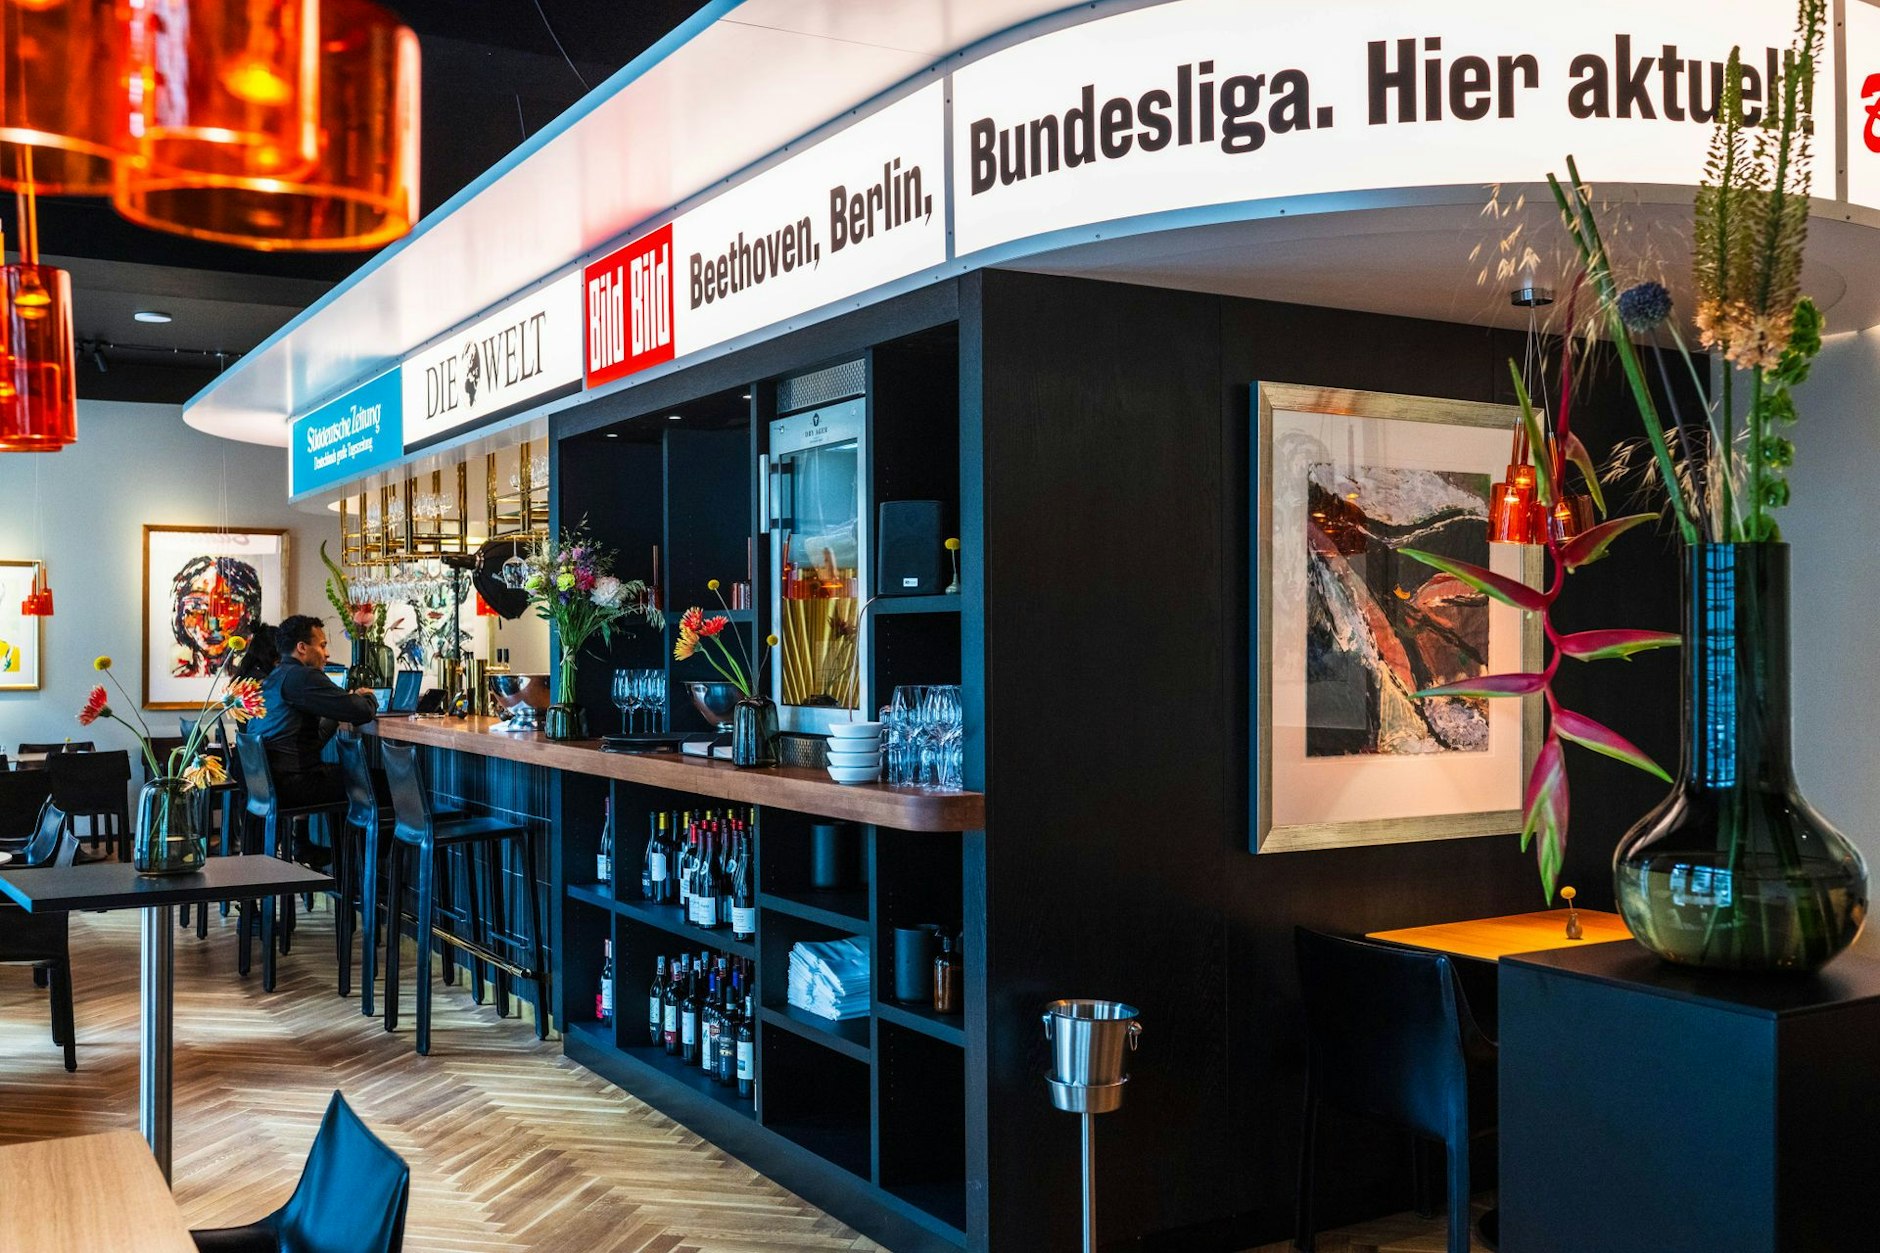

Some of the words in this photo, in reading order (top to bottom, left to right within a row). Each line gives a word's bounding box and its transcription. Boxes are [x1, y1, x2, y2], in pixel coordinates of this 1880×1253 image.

[690, 215, 821, 310] Beethoven,
[830, 157, 932, 253] Berlin,
[970, 60, 1334, 196] Bundesliga.
[1367, 35, 1539, 125] Hier
[426, 355, 459, 420] DIE
[482, 310, 547, 393] WELT
[589, 265, 625, 373] Bild
[630, 242, 671, 357] Bild
[307, 417, 351, 453] Süddeutsche
[350, 403, 382, 434] Zeitung
